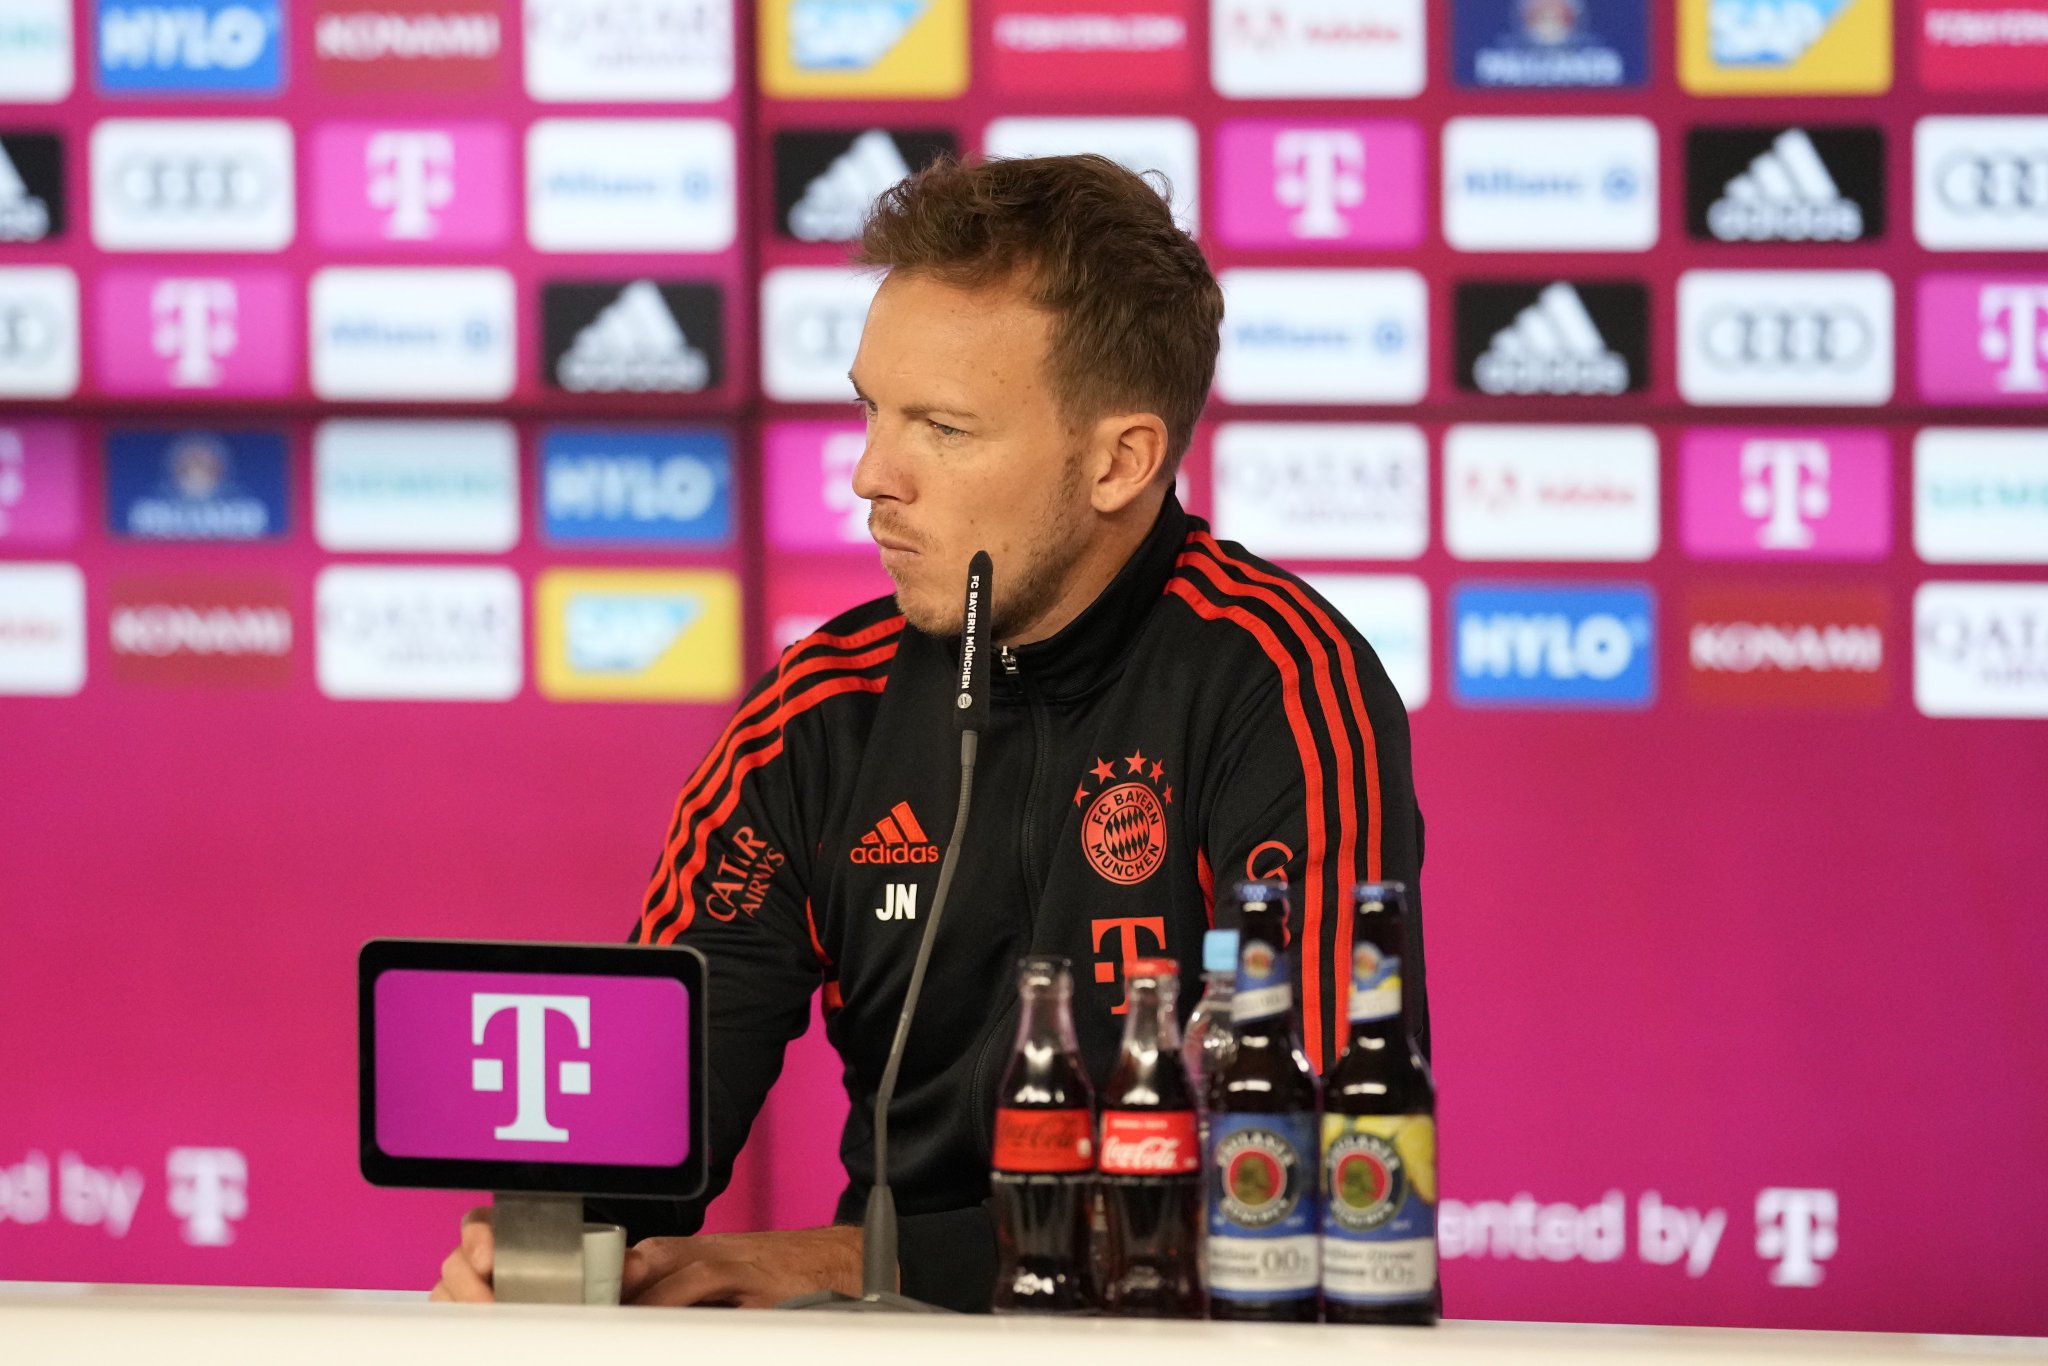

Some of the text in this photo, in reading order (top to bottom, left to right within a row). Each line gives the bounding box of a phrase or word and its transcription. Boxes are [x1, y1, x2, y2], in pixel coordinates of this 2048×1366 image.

[100, 5, 267, 70] HYLO
[970, 575, 980, 589] FC
[967, 592, 978, 634] BAYERN
[961, 636, 976, 690] MÜNCHEN
[1459, 611, 1635, 680] HYLO
[1690, 622, 1882, 672] KONAMI
[1092, 790, 1160, 826] FC BAYERN
[850, 843, 939, 865] adidas
[1091, 842, 1160, 877] MÜNCHEN
[875, 883, 918, 922] JN
[58, 1149, 145, 1240] by
[1638, 1189, 1728, 1278] by
